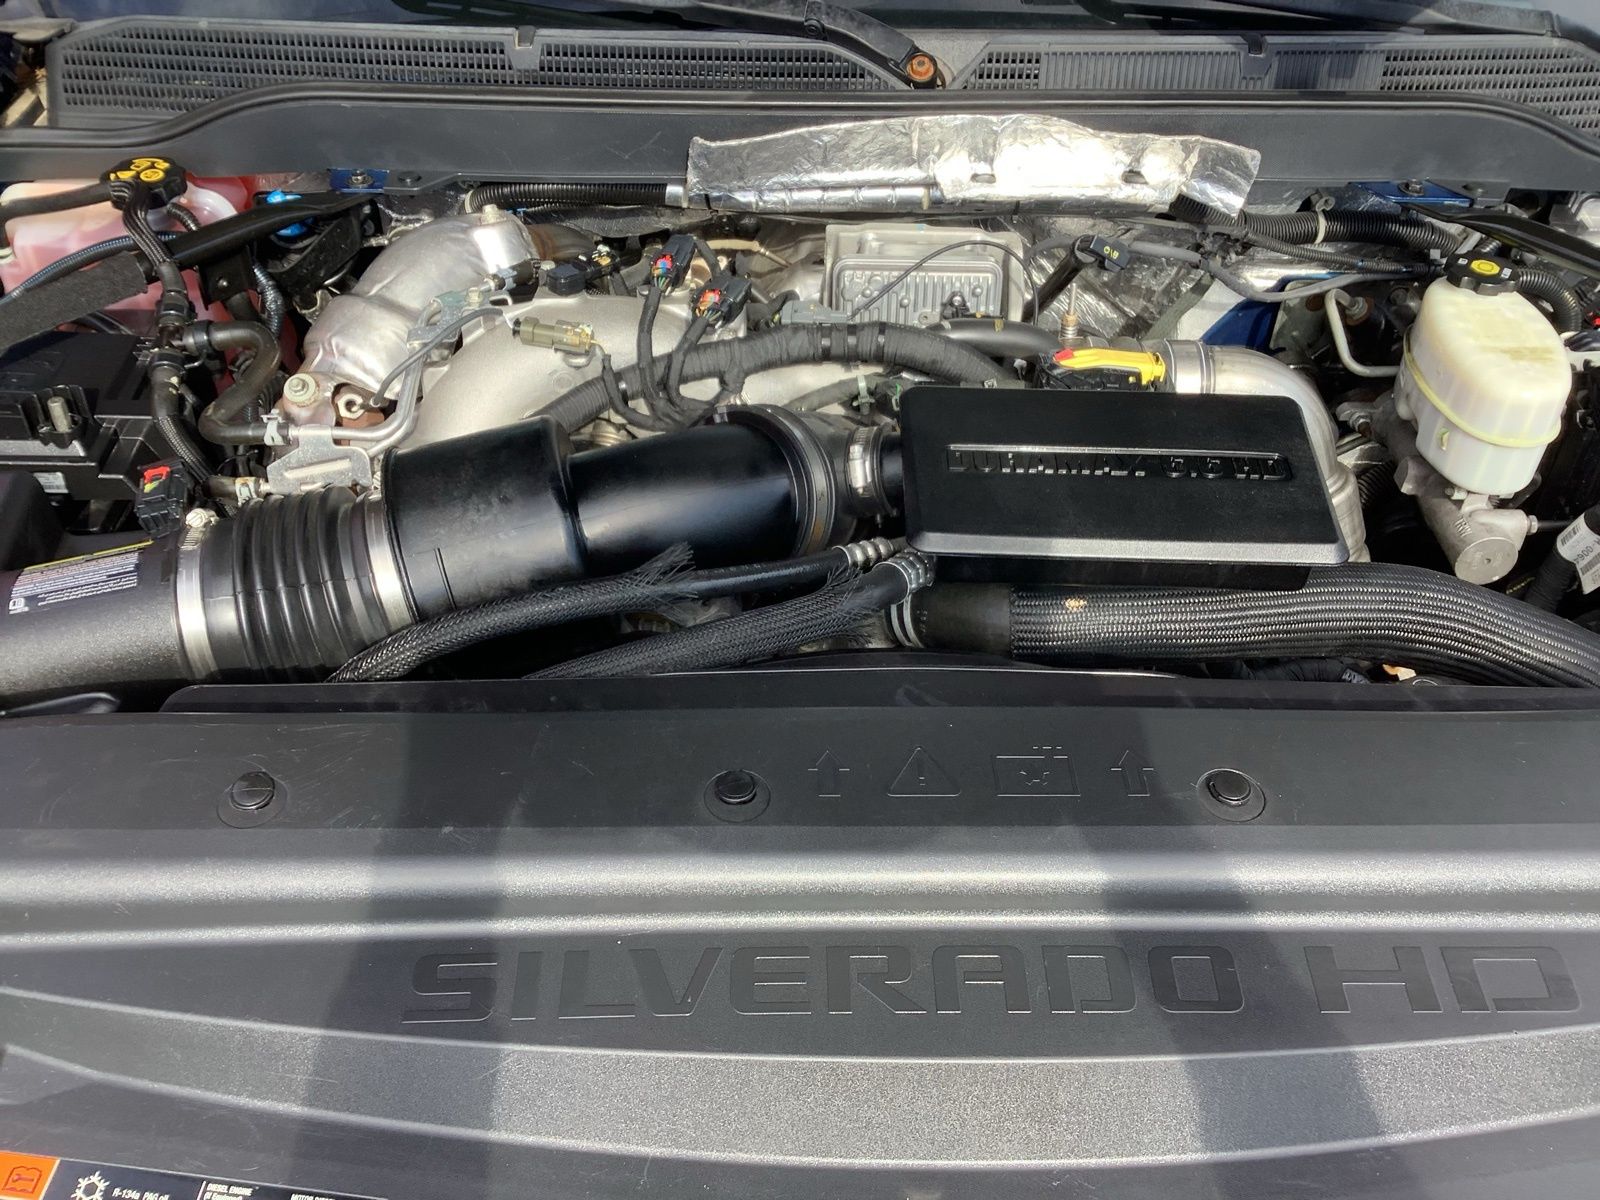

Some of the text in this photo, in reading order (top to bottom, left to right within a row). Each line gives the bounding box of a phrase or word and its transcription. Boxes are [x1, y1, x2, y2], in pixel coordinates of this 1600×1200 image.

[402, 945, 1581, 1023] SILVERADO HD
[112, 1187, 141, 1200] R-134a
[206, 1182, 254, 1196] DIESEL ENGINE
